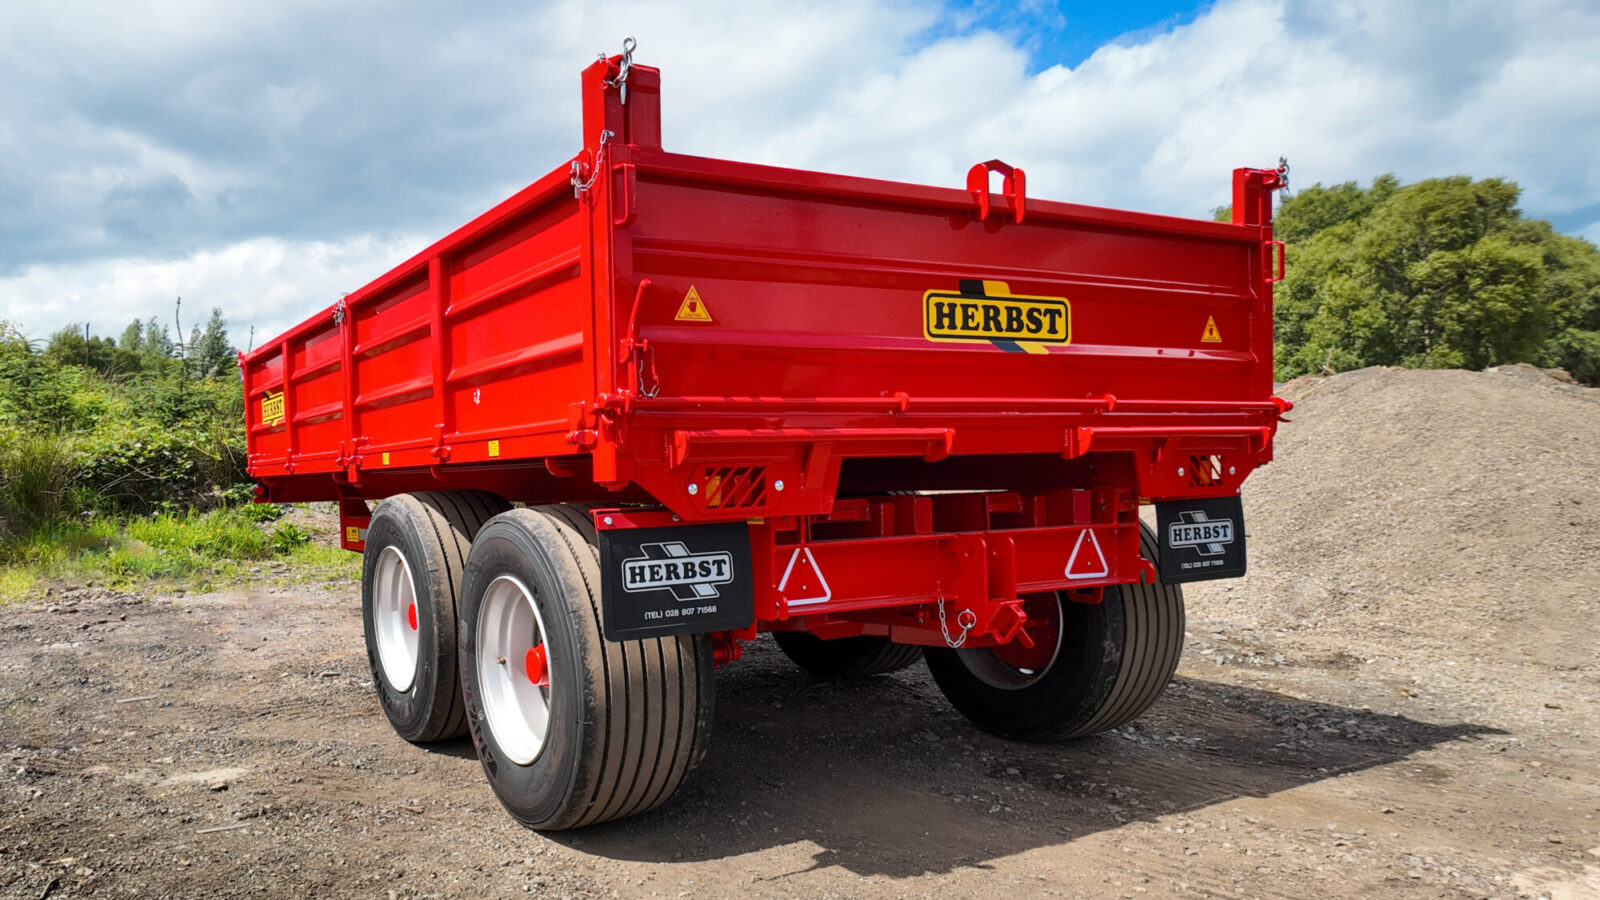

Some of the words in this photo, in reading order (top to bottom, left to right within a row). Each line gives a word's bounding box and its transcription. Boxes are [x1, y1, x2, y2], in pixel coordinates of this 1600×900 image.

[934, 302, 1062, 335] HERBST
[1173, 525, 1229, 542] HERBST
[628, 559, 726, 584] HERBST
[644, 610, 663, 620] (TEL)
[665, 609, 679, 617] 028
[681, 607, 695, 616] 807
